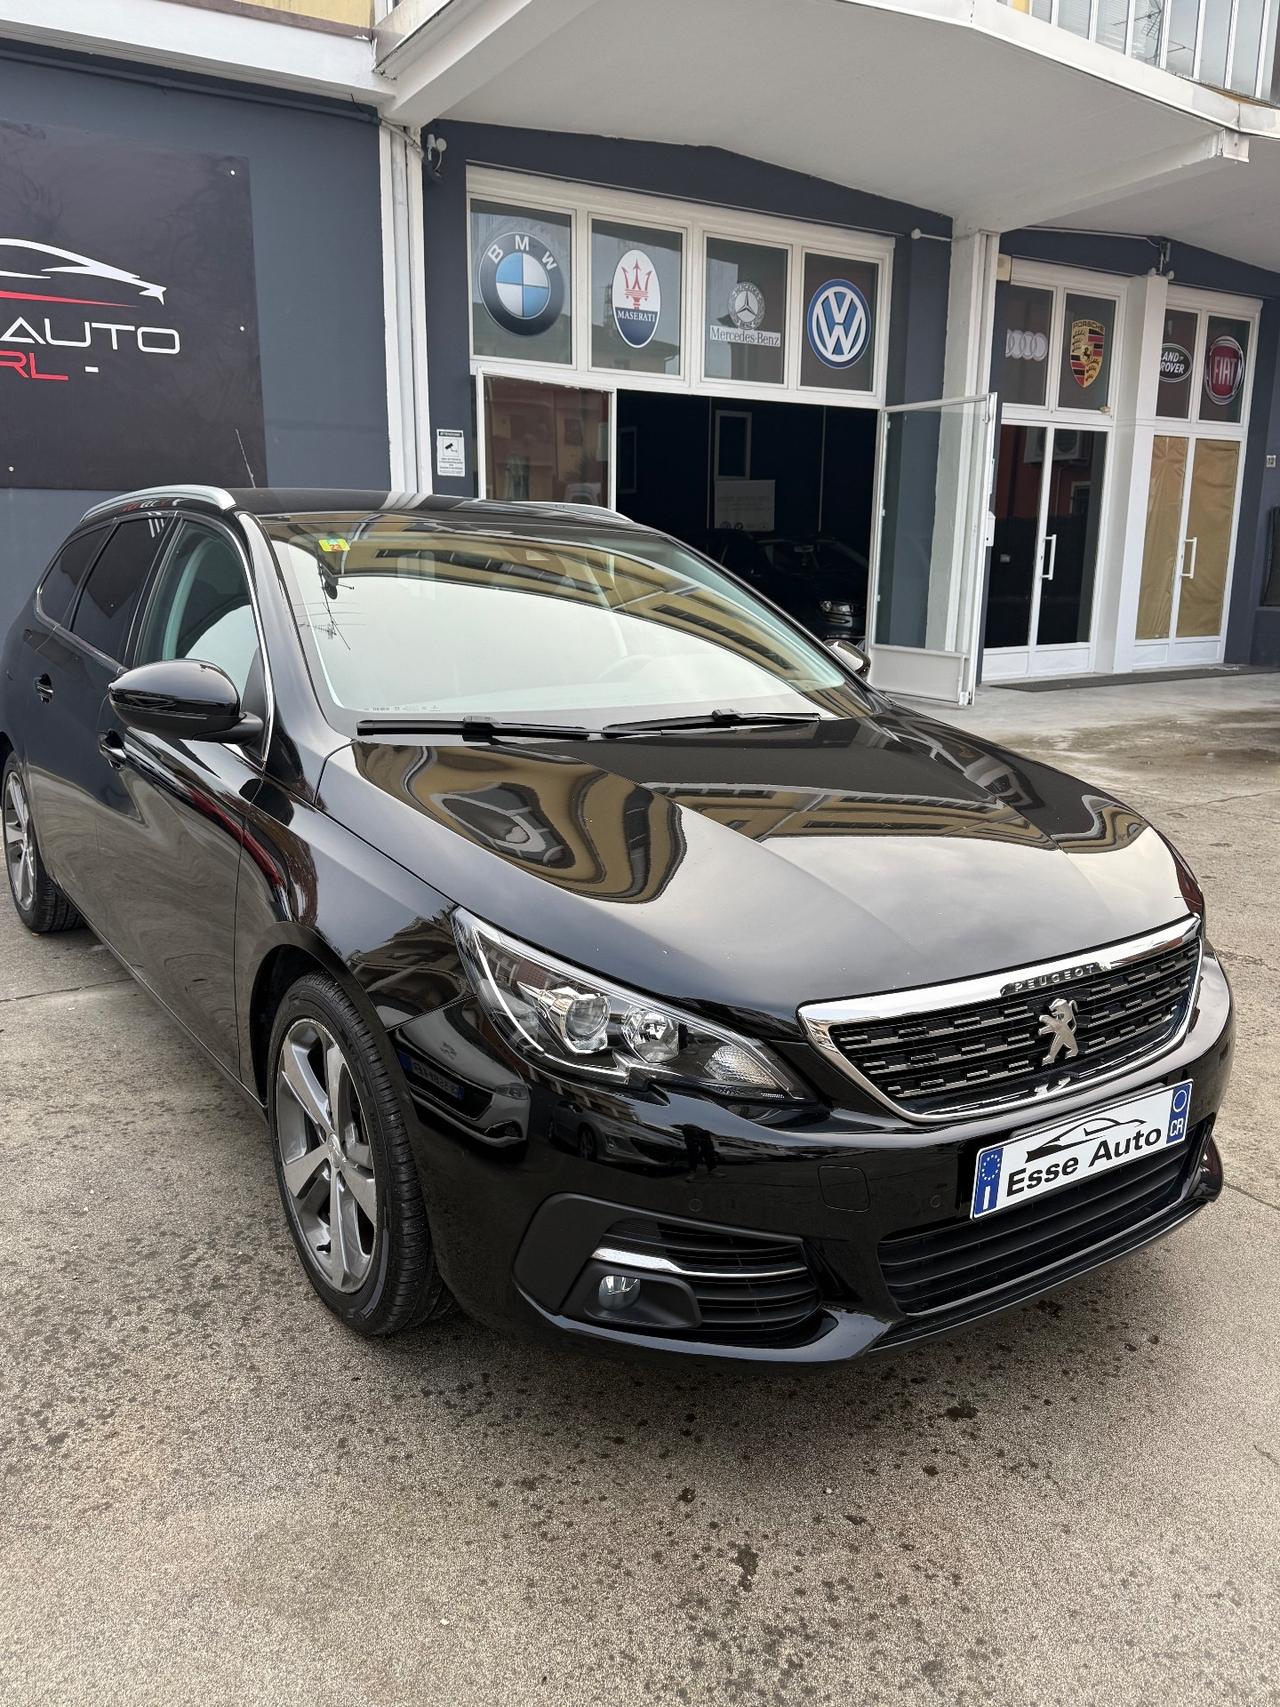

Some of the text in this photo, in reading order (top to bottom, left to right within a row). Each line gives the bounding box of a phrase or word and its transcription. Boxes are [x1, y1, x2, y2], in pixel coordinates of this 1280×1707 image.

[487, 234, 558, 271] BMW
[617, 310, 656, 323] MASERATI
[0, 316, 181, 355] AUTO
[1160, 362, 1185, 374] ROVER
[1213, 356, 1237, 385] FIAT
[1014, 964, 1095, 992] PEUGEOT
[1170, 1117, 1184, 1137] CR
[1006, 1127, 1162, 1197] Esse Auto
[982, 1185, 991, 1210] I
